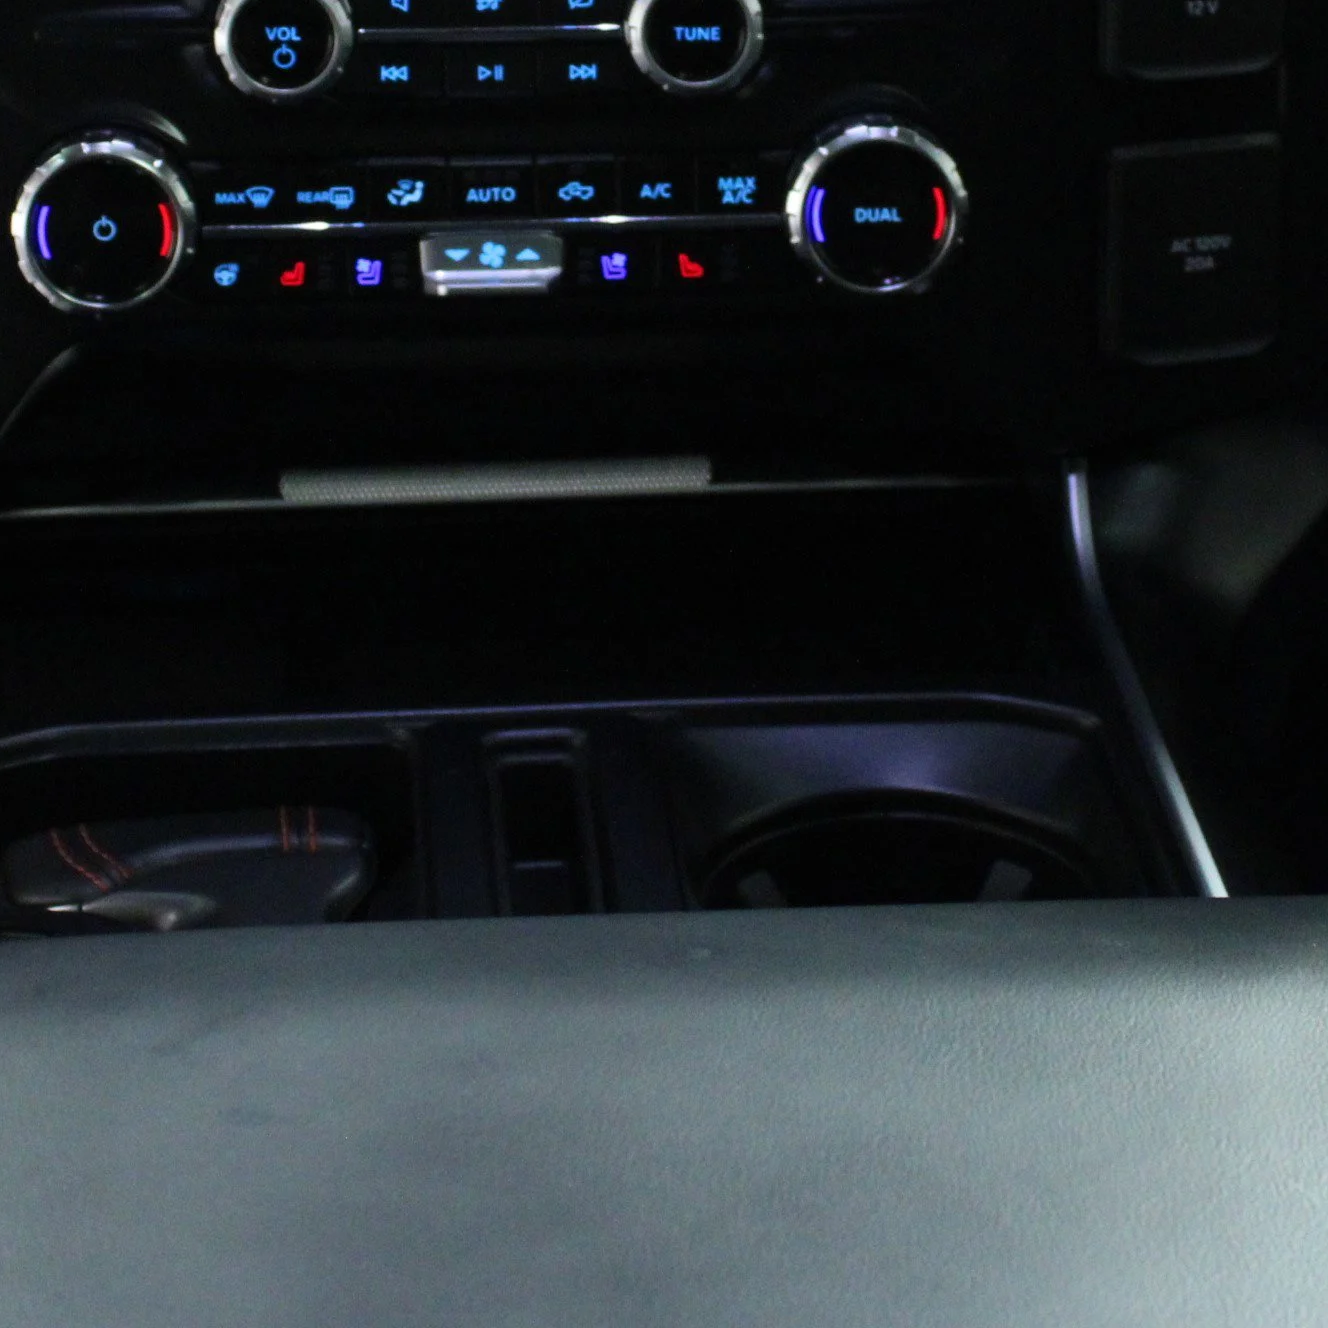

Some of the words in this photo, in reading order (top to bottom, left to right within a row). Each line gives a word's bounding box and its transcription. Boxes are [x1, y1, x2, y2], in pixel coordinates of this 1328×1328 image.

[265, 26, 301, 43] VOL
[673, 26, 721, 42] TUNE
[640, 182, 673, 199] A/C
[718, 177, 756, 191] MAX
[215, 192, 246, 204] MAX
[296, 191, 330, 203] REAR
[466, 186, 516, 204] AUTO
[722, 189, 753, 205] A/C
[854, 206, 902, 224] DUAL
